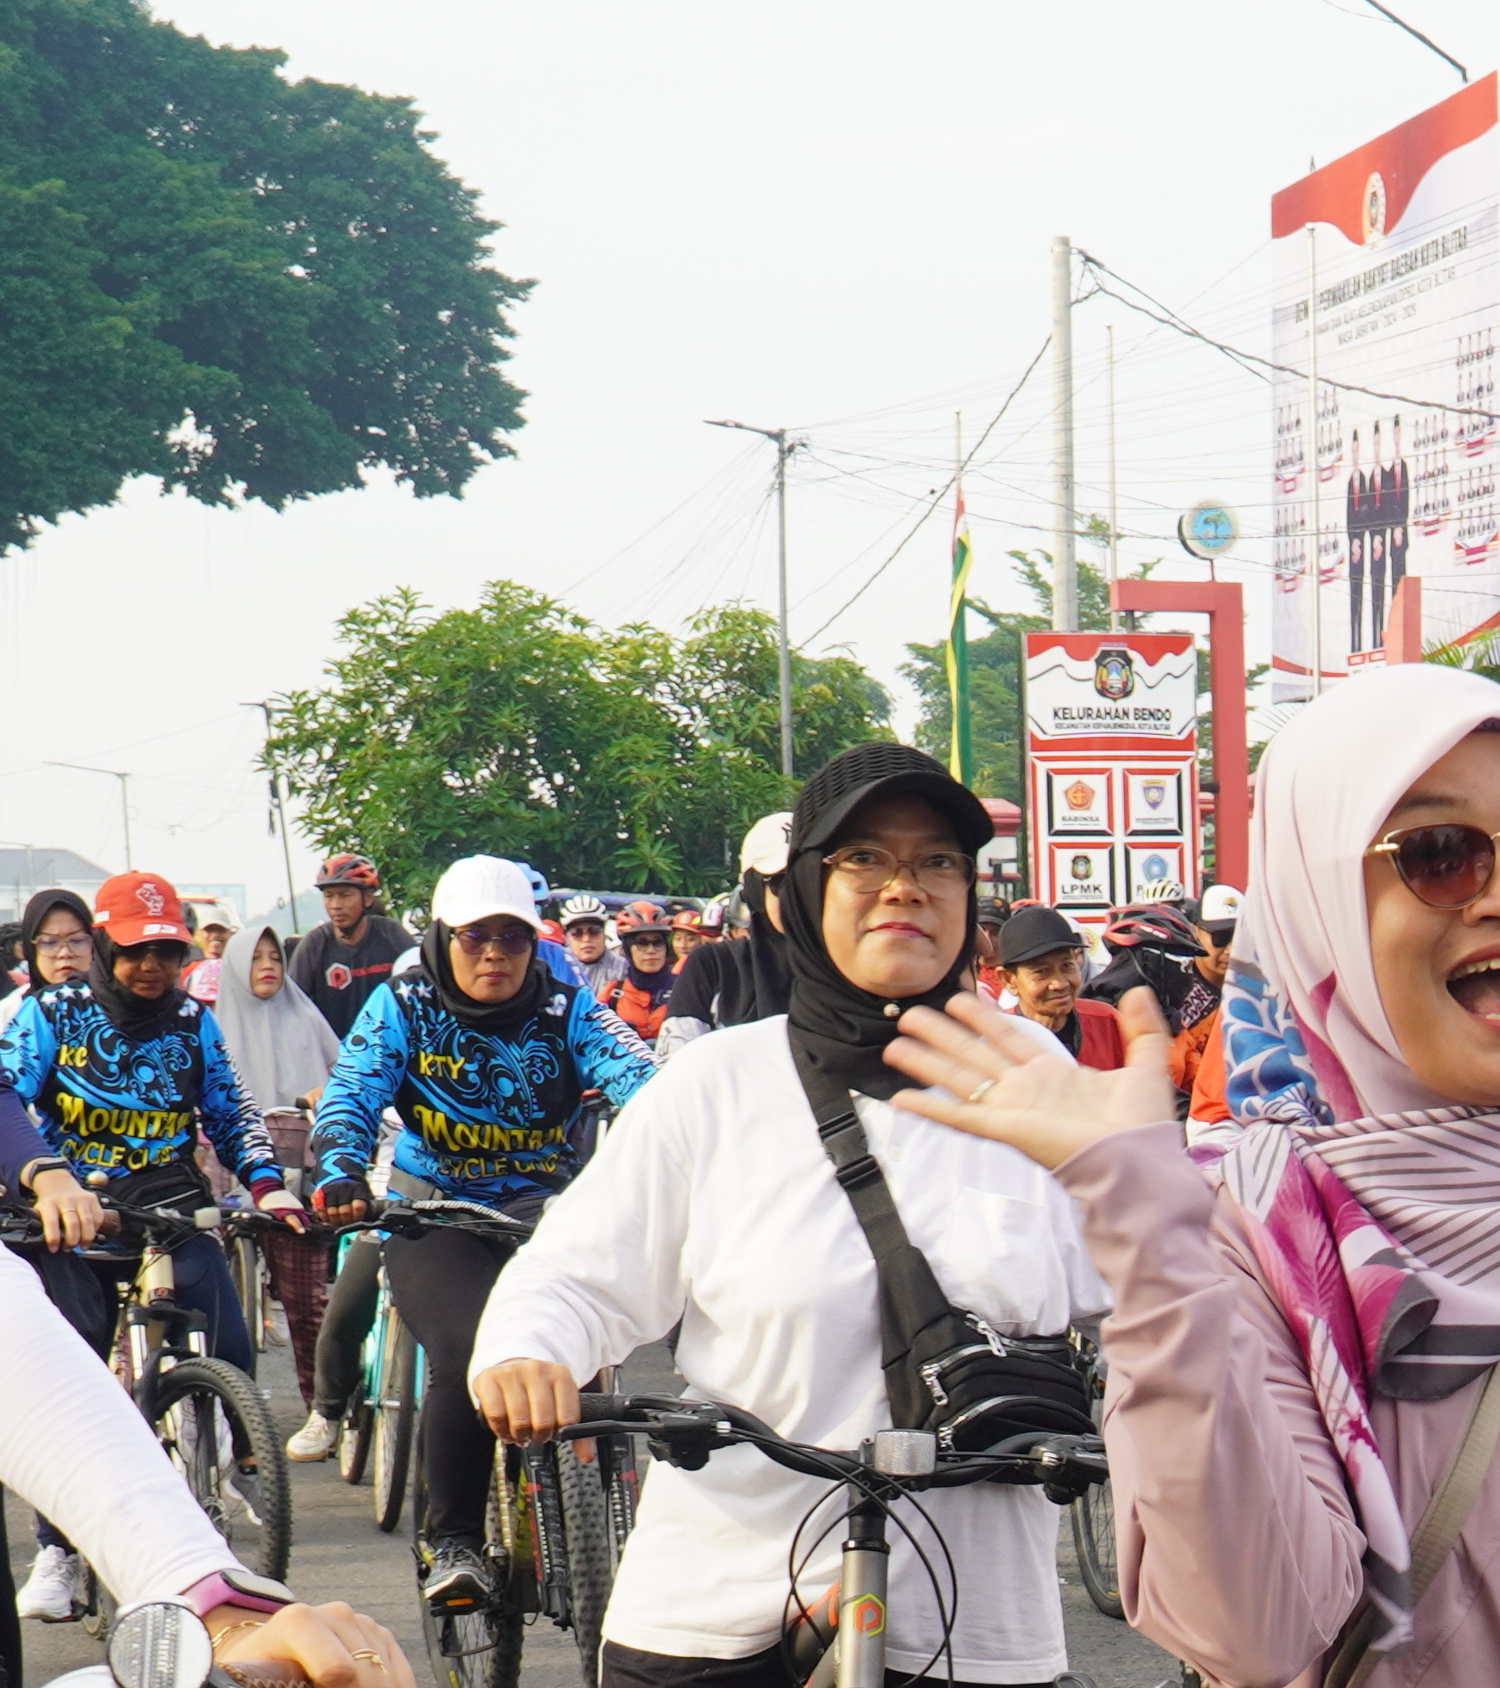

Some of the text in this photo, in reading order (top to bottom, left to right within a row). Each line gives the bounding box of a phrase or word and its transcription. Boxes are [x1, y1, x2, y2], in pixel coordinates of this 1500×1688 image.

[1053, 706, 1172, 721] KELURAHAN BENDO
[1061, 883, 1103, 895] LPMK
[59, 1139, 126, 1169] CYCLE
